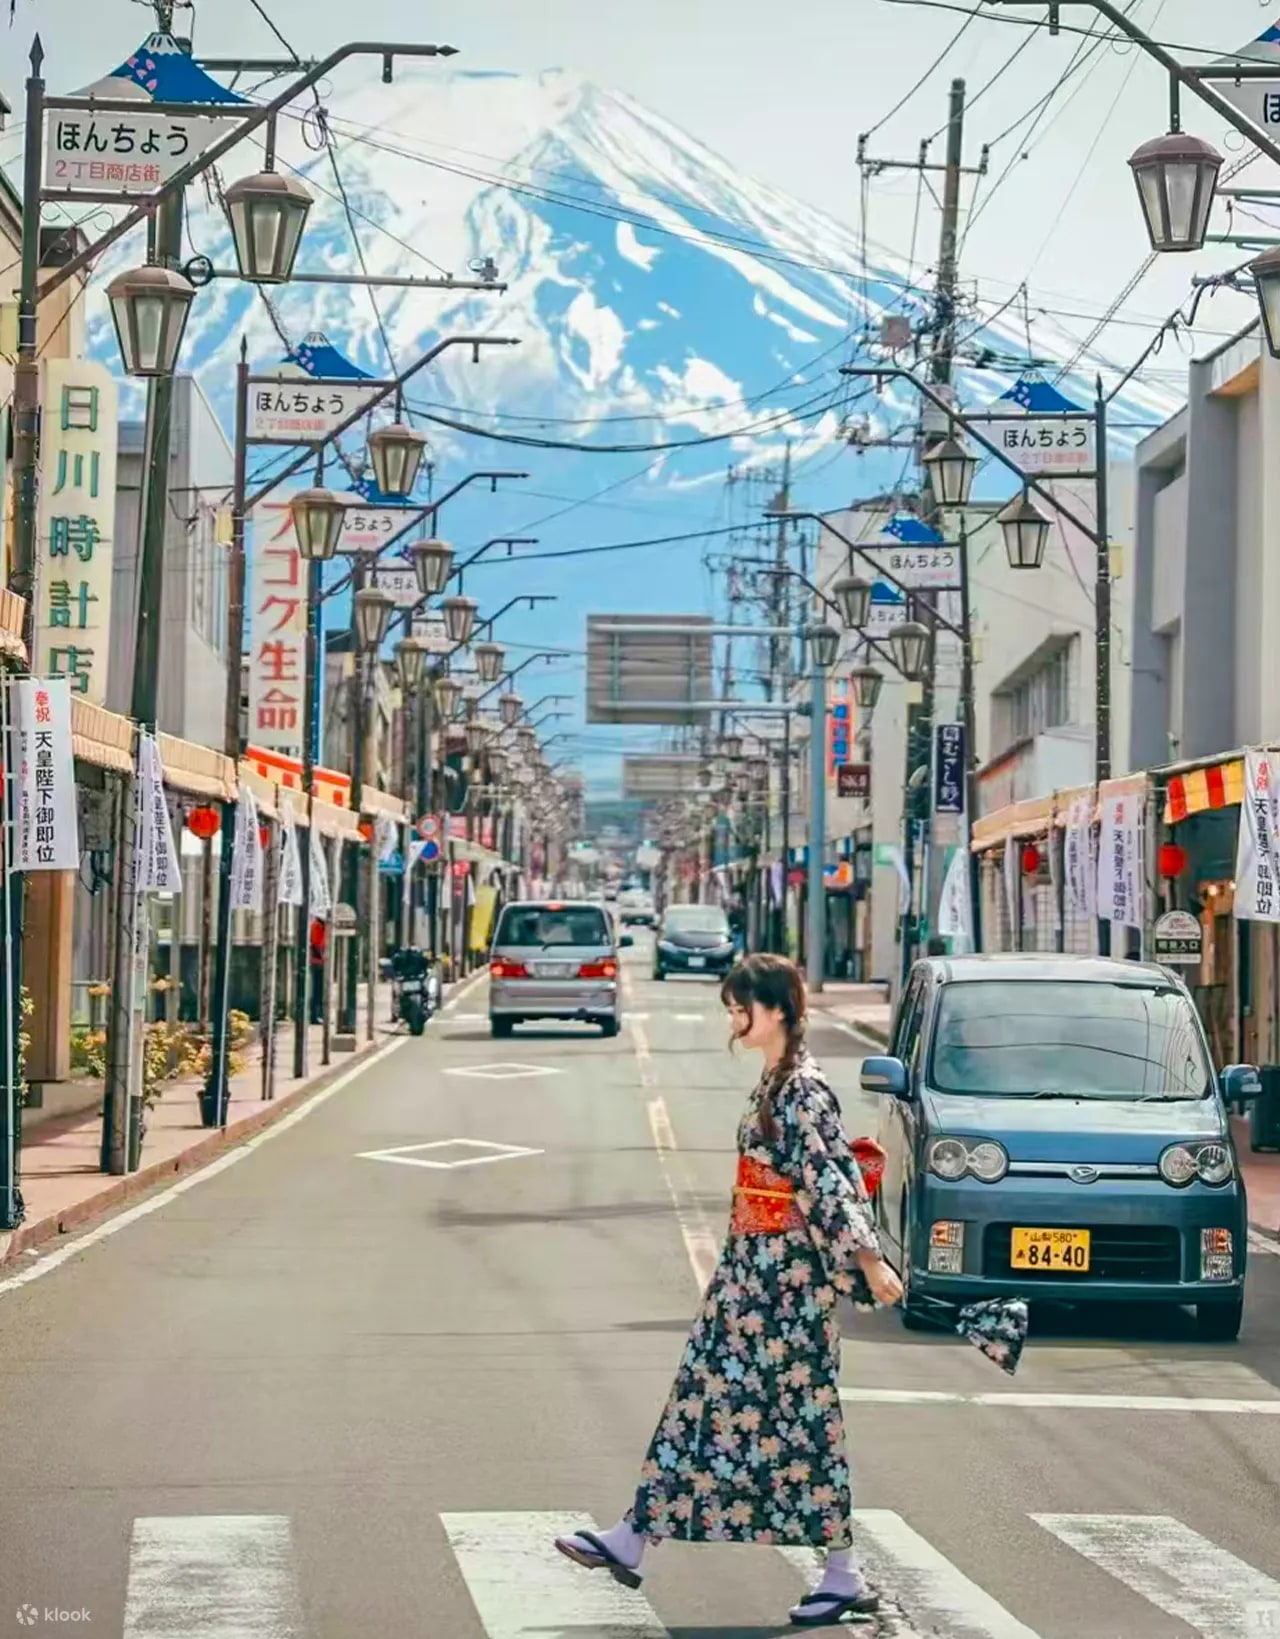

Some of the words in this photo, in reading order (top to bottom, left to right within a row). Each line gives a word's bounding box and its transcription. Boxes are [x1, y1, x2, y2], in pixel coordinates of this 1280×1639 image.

[57, 121, 188, 156] ほんちょう
[55, 160, 160, 182] 2丁目商店街
[256, 391, 344, 415] ほんちょう
[1004, 427, 1087, 448] ほんちょう
[342, 516, 393, 532] んちょう
[49, 384, 100, 694] 日川時計店
[890, 551, 954, 569] ほんちょう
[35, 690, 51, 723] 奉祝
[35, 731, 56, 863] 天皇陛下御即位
[1028, 1245, 1085, 1267] 84-40
